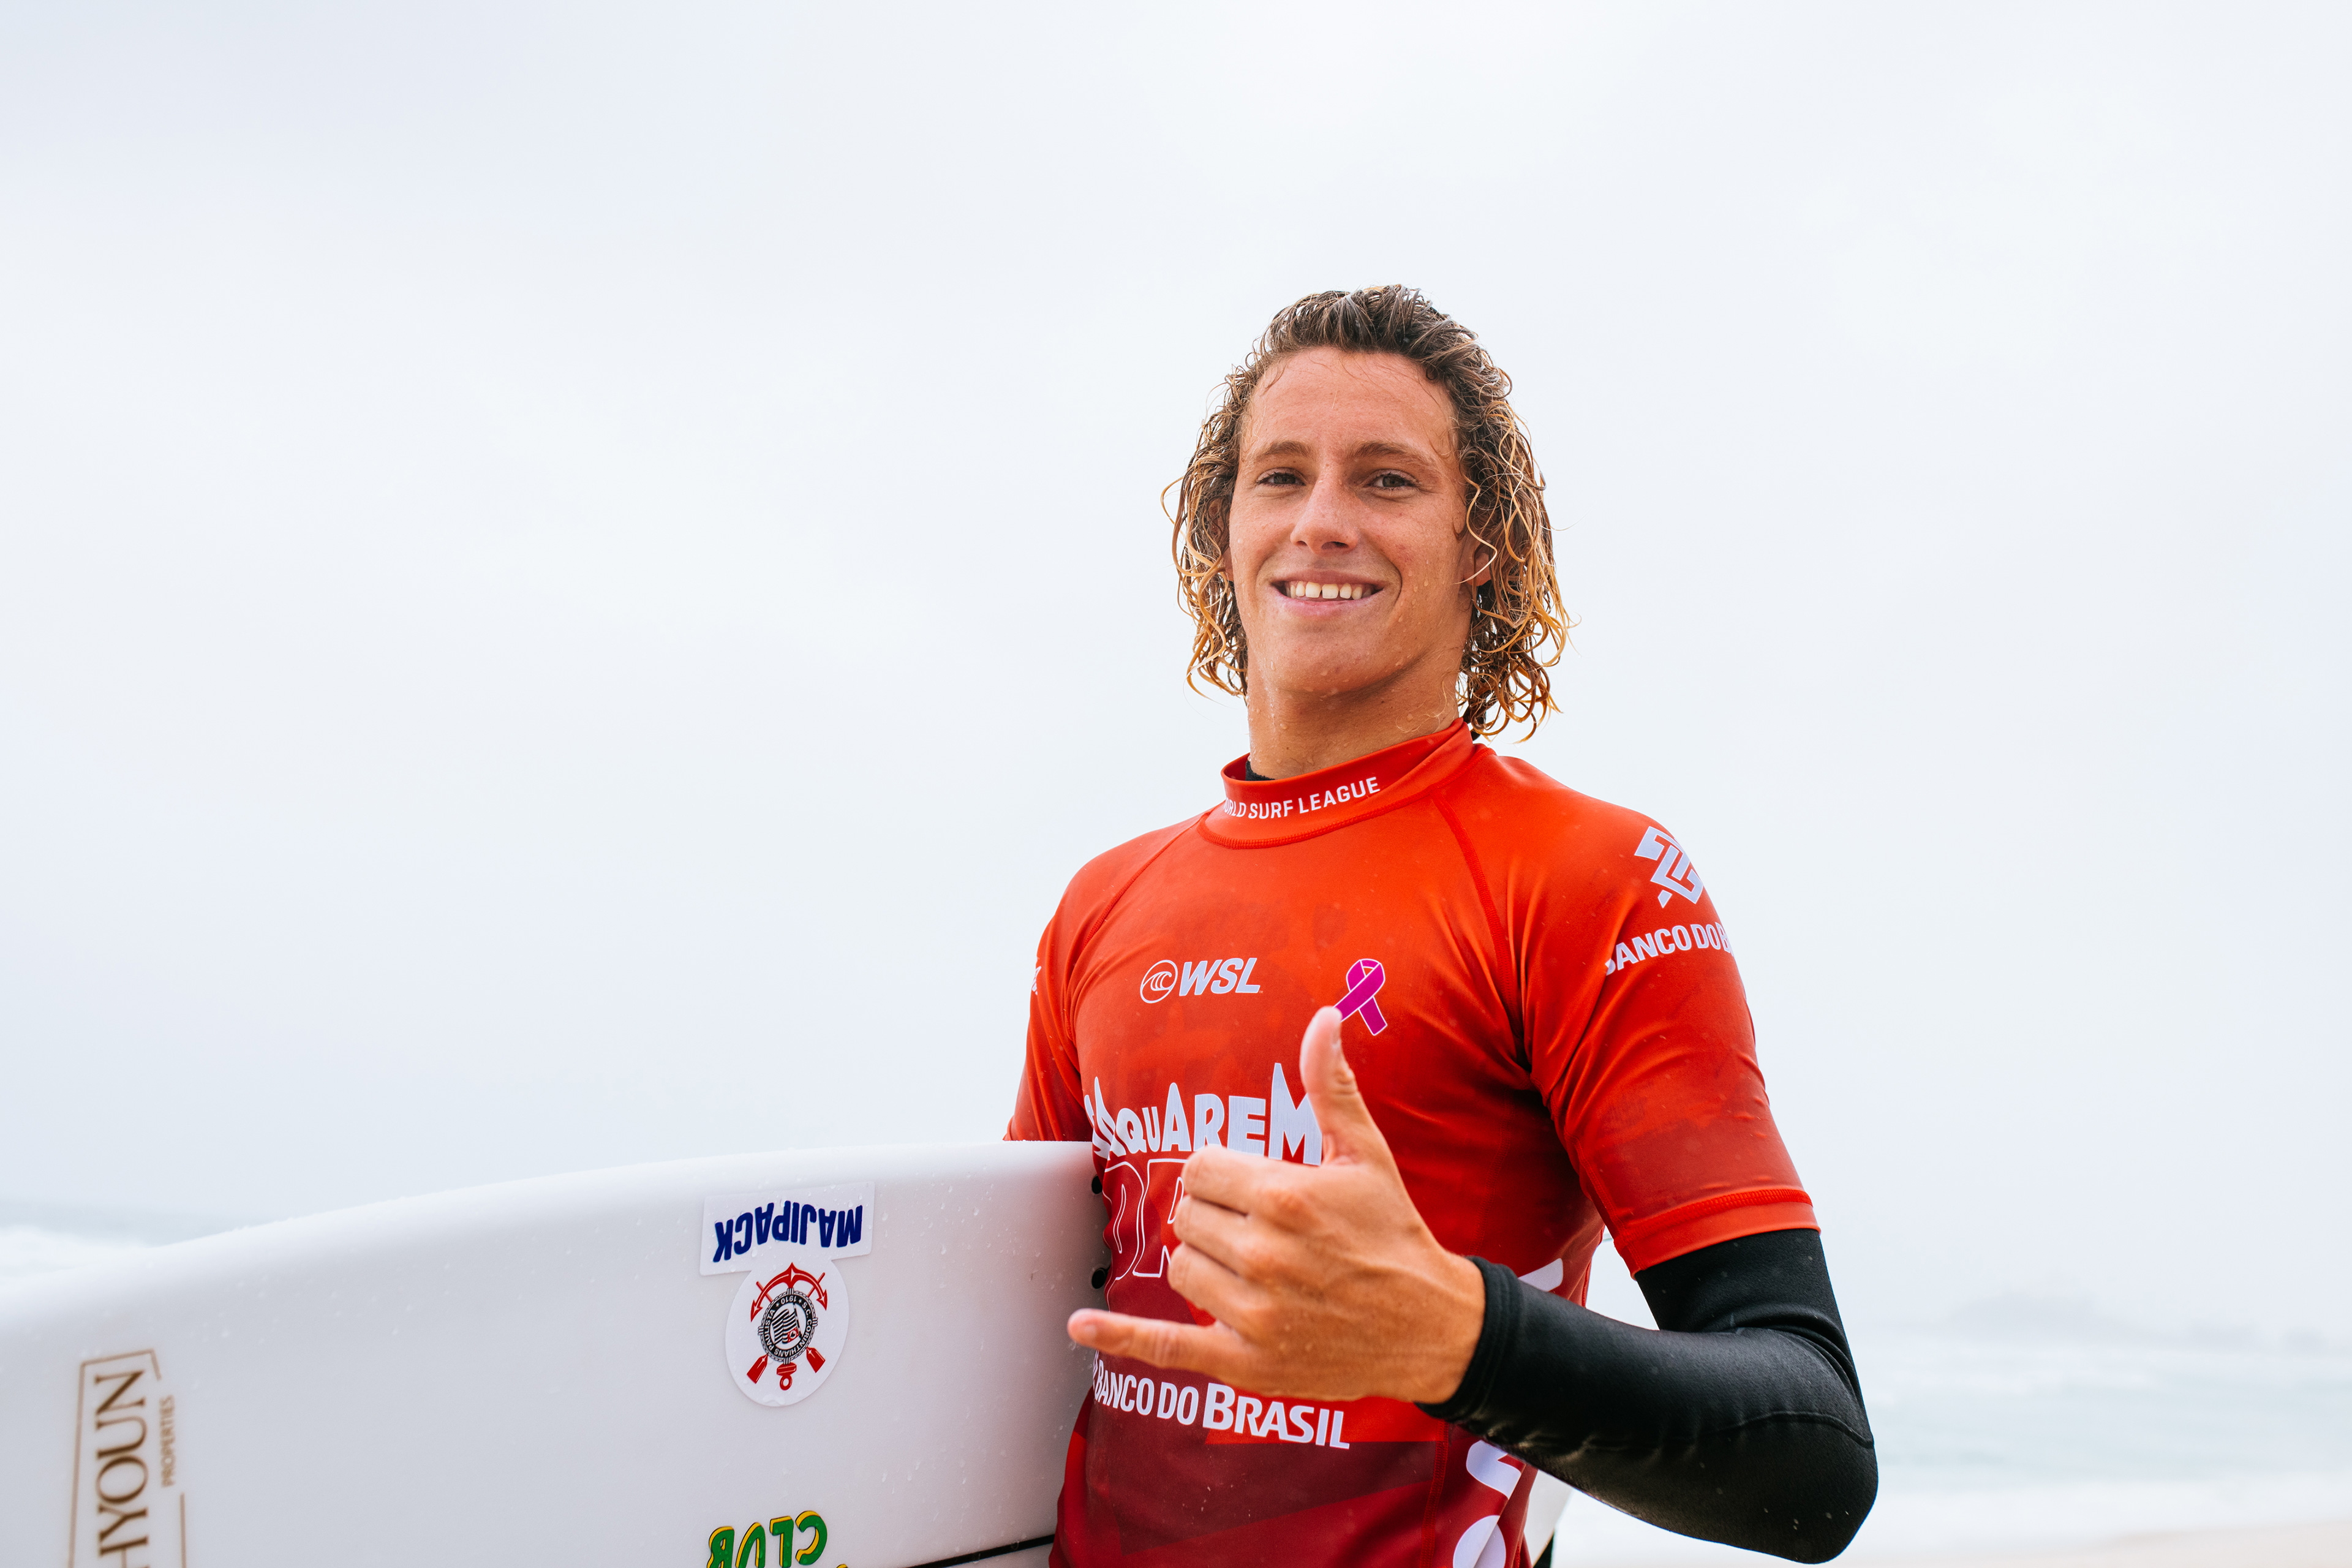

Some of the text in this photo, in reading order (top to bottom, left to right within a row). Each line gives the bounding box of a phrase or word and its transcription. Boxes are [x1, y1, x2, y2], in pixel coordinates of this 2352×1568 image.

[1224, 776, 1381, 819] ORLD SURF LEAGUE
[1690, 924, 1721, 950] DO
[1178, 957, 1261, 997] WSL
[712, 1200, 863, 1263] MAJIPACK
[780, 1295, 797, 1305] 1910
[764, 1309, 775, 1351] PAULISTA
[774, 1319, 812, 1357] CORINTHIANS
[1095, 1359, 1350, 1450] BANCO DO BRASIL
[706, 1510, 827, 1568] CLUB
